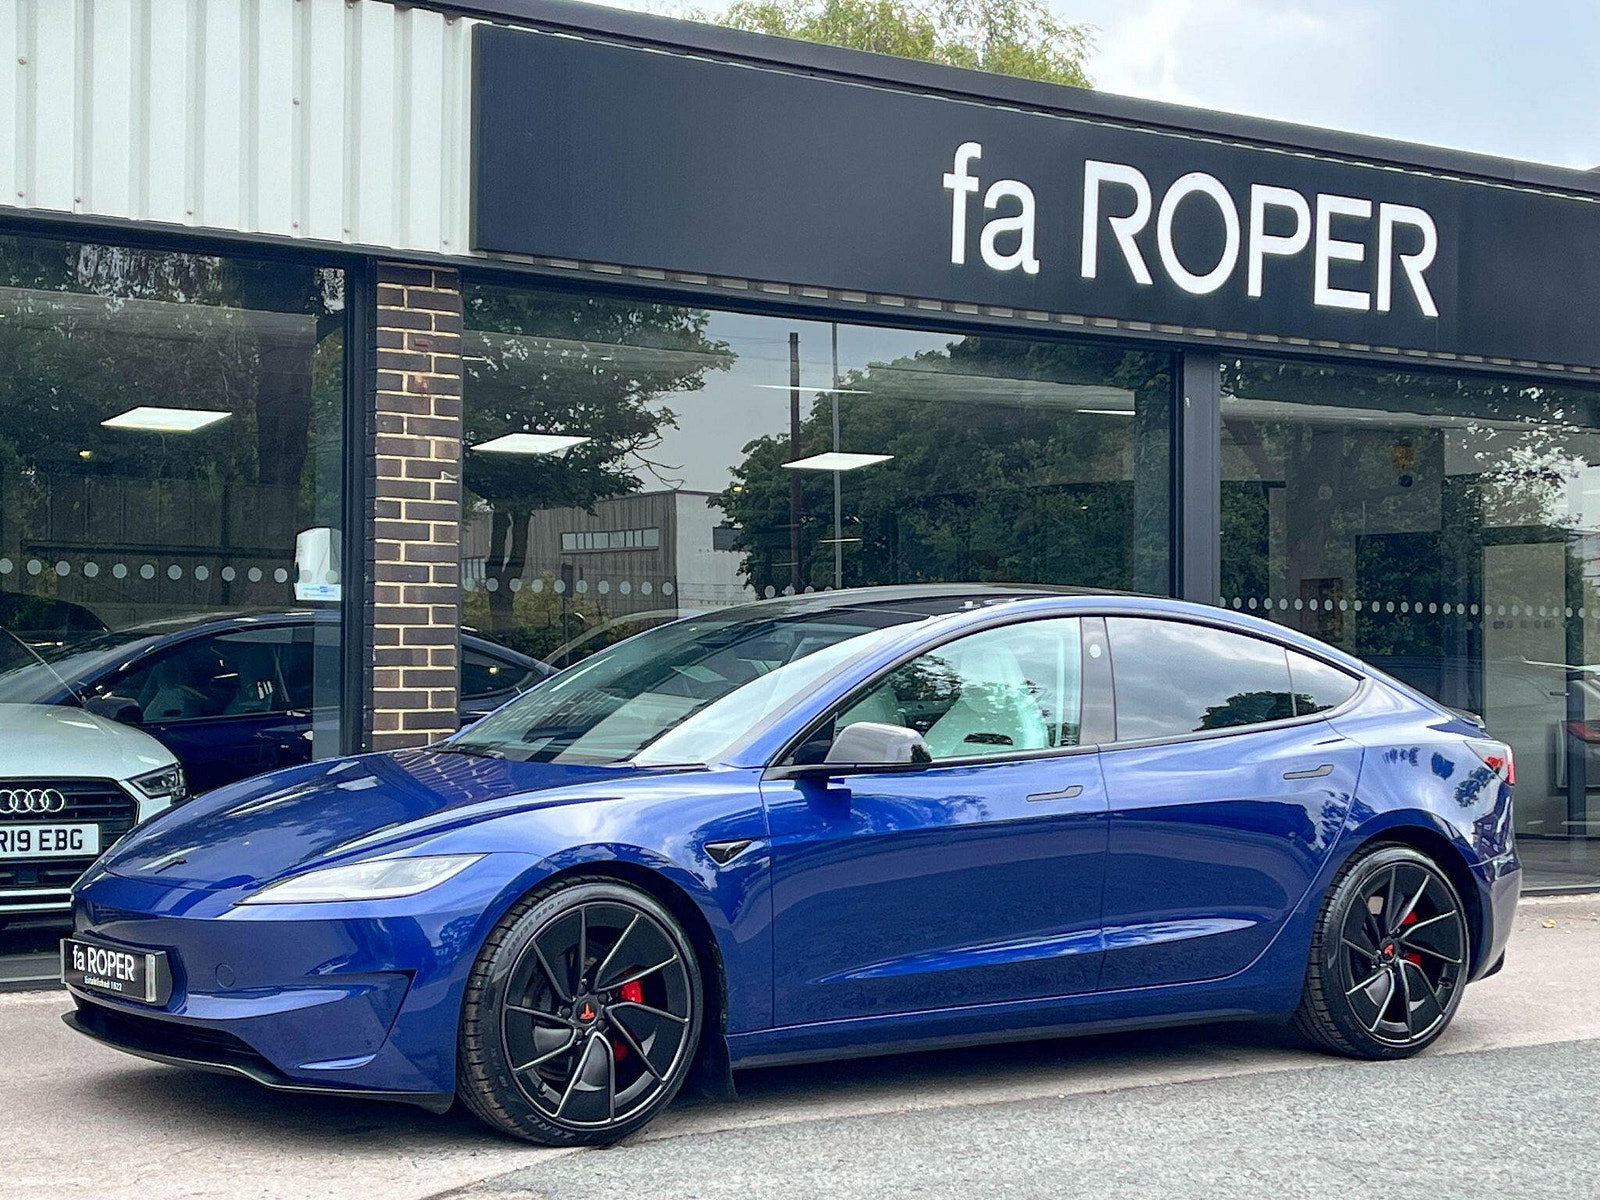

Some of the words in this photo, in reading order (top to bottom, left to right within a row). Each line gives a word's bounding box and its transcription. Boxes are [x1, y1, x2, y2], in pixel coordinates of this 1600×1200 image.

[943, 142, 1039, 274] fa
[1081, 160, 1439, 317] ROPER
[39, 829, 83, 851] EBG
[73, 945, 85, 971] fa
[87, 947, 135, 982] ROPER
